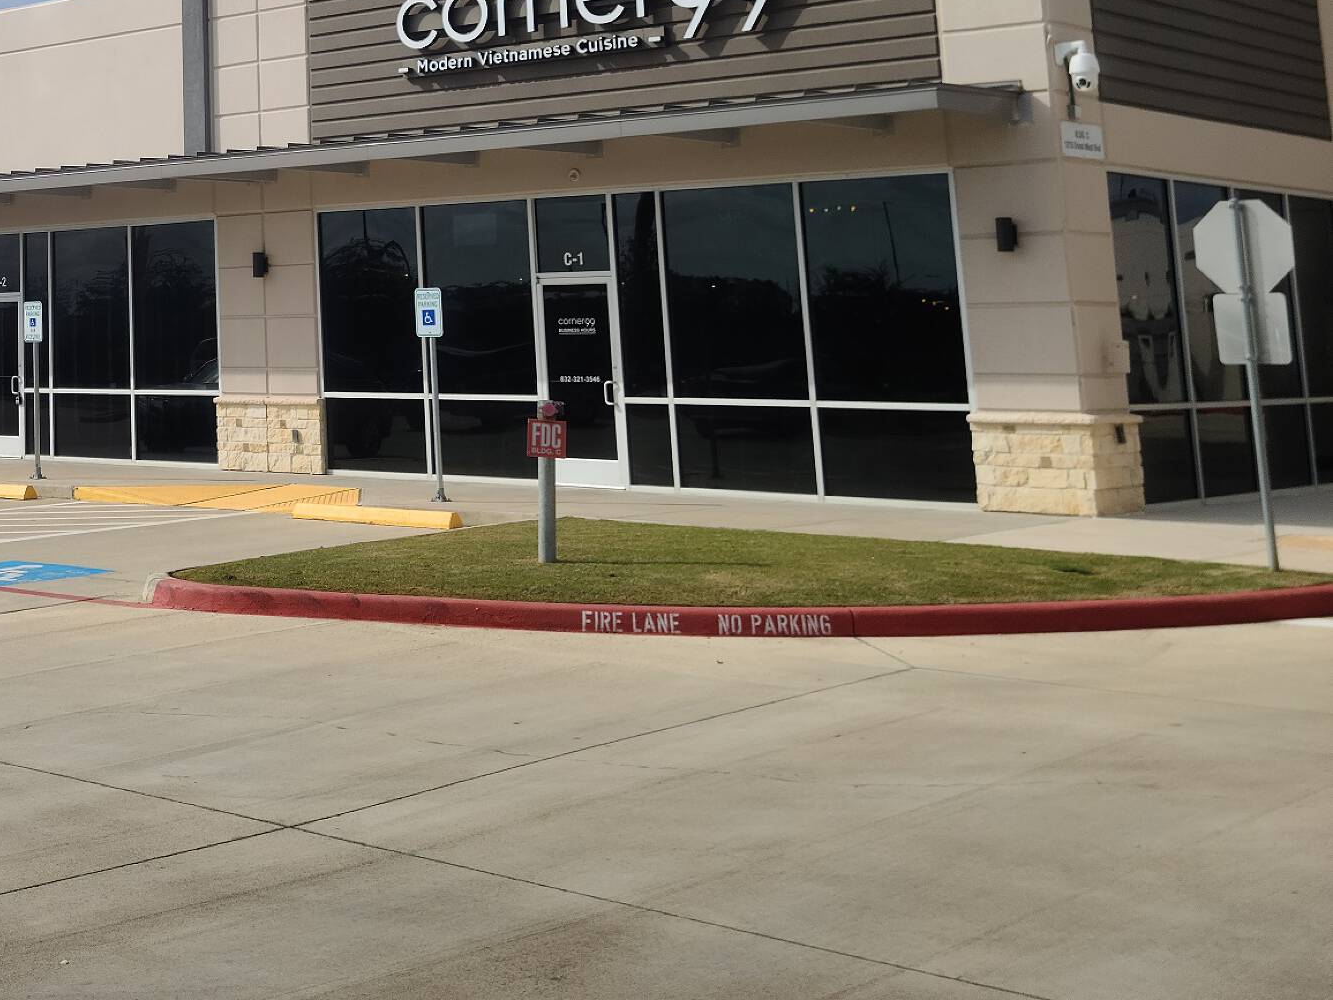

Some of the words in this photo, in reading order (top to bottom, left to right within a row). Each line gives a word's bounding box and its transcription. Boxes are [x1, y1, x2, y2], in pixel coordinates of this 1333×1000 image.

[416, 55, 473, 76] Modern
[477, 42, 571, 66] Vietnamese
[576, 33, 639, 55] Cuisine
[563, 252, 584, 266] C-1
[557, 316, 596, 327] corner99
[531, 422, 562, 450] FDC
[581, 610, 623, 632] FIRE
[631, 612, 682, 634] LANE
[717, 613, 743, 635] NO
[750, 613, 832, 636] PARKING
